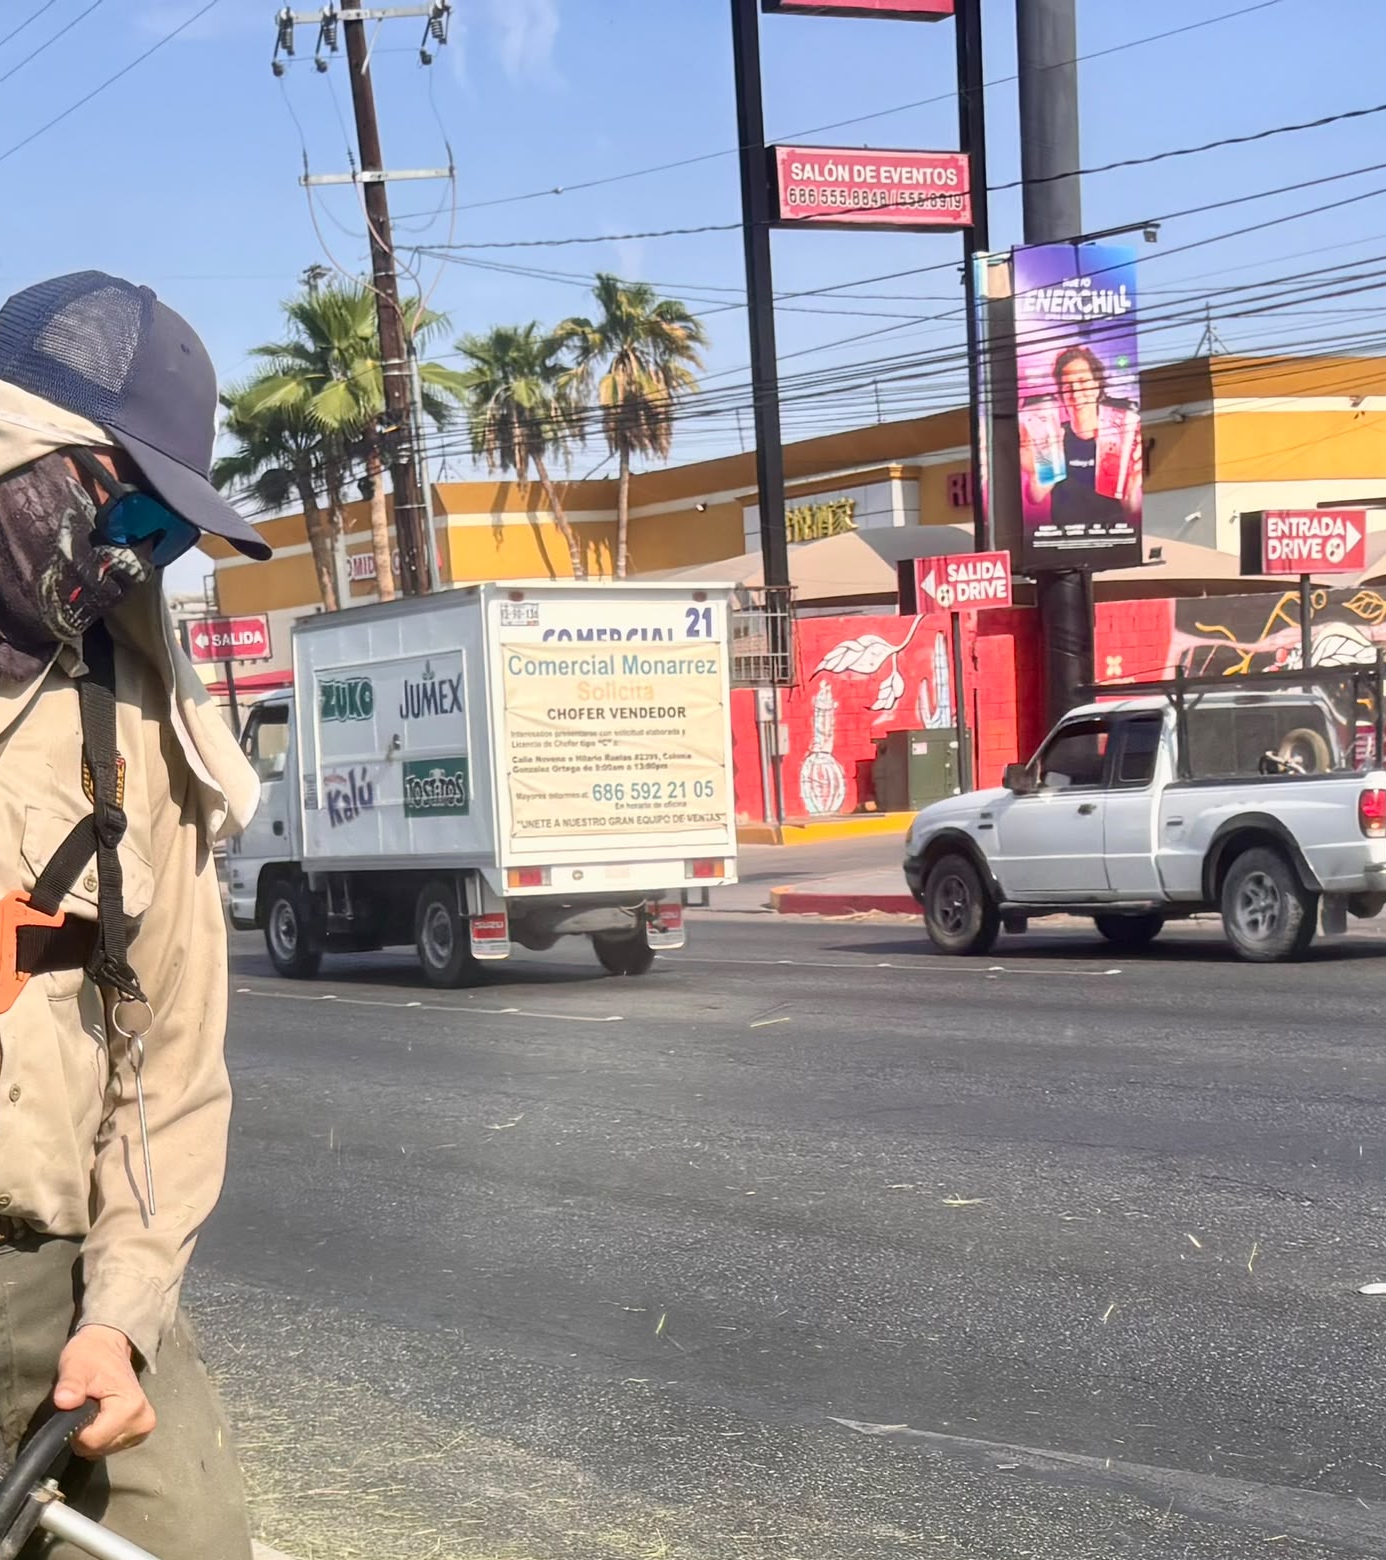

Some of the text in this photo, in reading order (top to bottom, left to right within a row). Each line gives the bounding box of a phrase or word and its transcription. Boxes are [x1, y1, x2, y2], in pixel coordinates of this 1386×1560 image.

[791, 160, 957, 185] SALÓN DE EVENTOS
[789, 187, 816, 205] 686
[1267, 517, 1345, 538] ENTRADA
[1267, 538, 1323, 560] DRIVE
[947, 561, 1005, 582] SALIDA
[957, 580, 1007, 601] DRIVE
[685, 607, 712, 637] 21
[212, 630, 264, 647] SALIDA
[508, 654, 717, 675] Comercial Monarrez
[319, 677, 374, 722] ZUKO
[400, 673, 462, 719] JUMEX
[577, 681, 654, 702] Solicita
[547, 707, 686, 720] CHOFER VENDEDOR
[592, 780, 714, 801] 686 592 21 05
[554, 819, 560, 828] A
[562, 817, 606, 827] NUESTRO
[608, 816, 634, 826] GRAN
[636, 815, 671, 825] EQUIPO
[673, 814, 684, 823] DE
